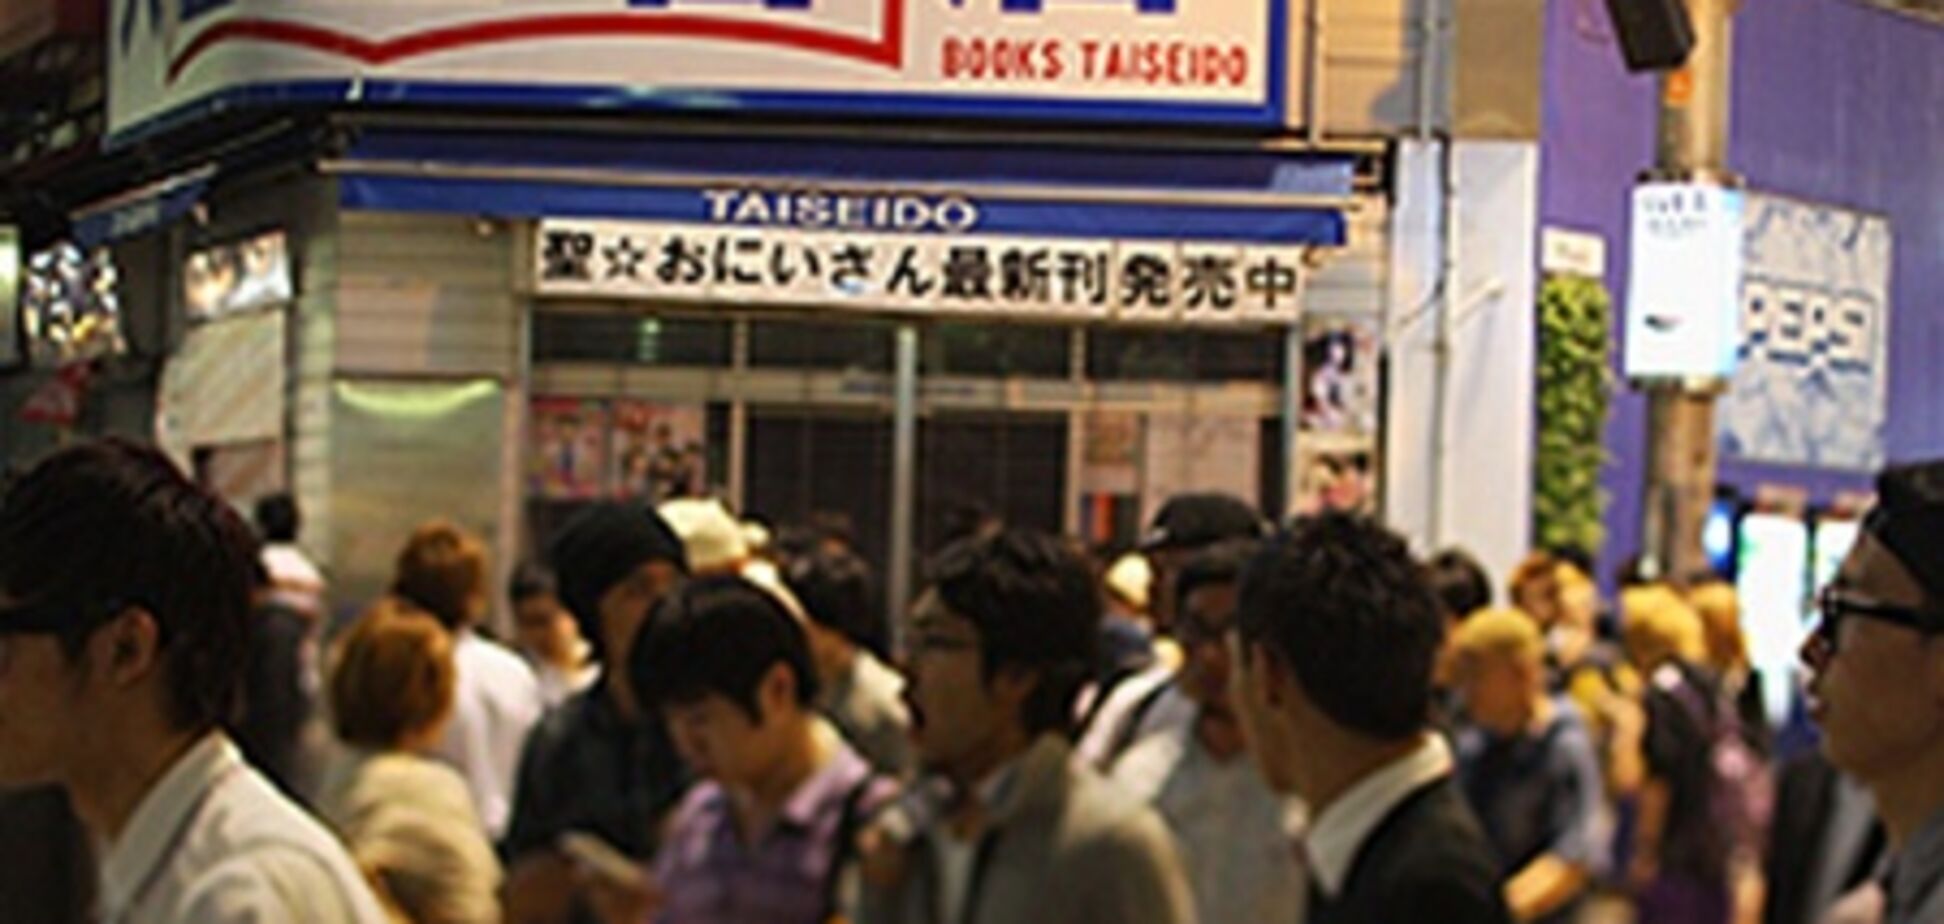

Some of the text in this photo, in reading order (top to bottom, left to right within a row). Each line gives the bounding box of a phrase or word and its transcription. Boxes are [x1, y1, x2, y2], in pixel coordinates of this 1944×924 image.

[941, 37, 1248, 87] BOOKS TAISEIDO
[702, 188, 979, 232] TAISEIDO
